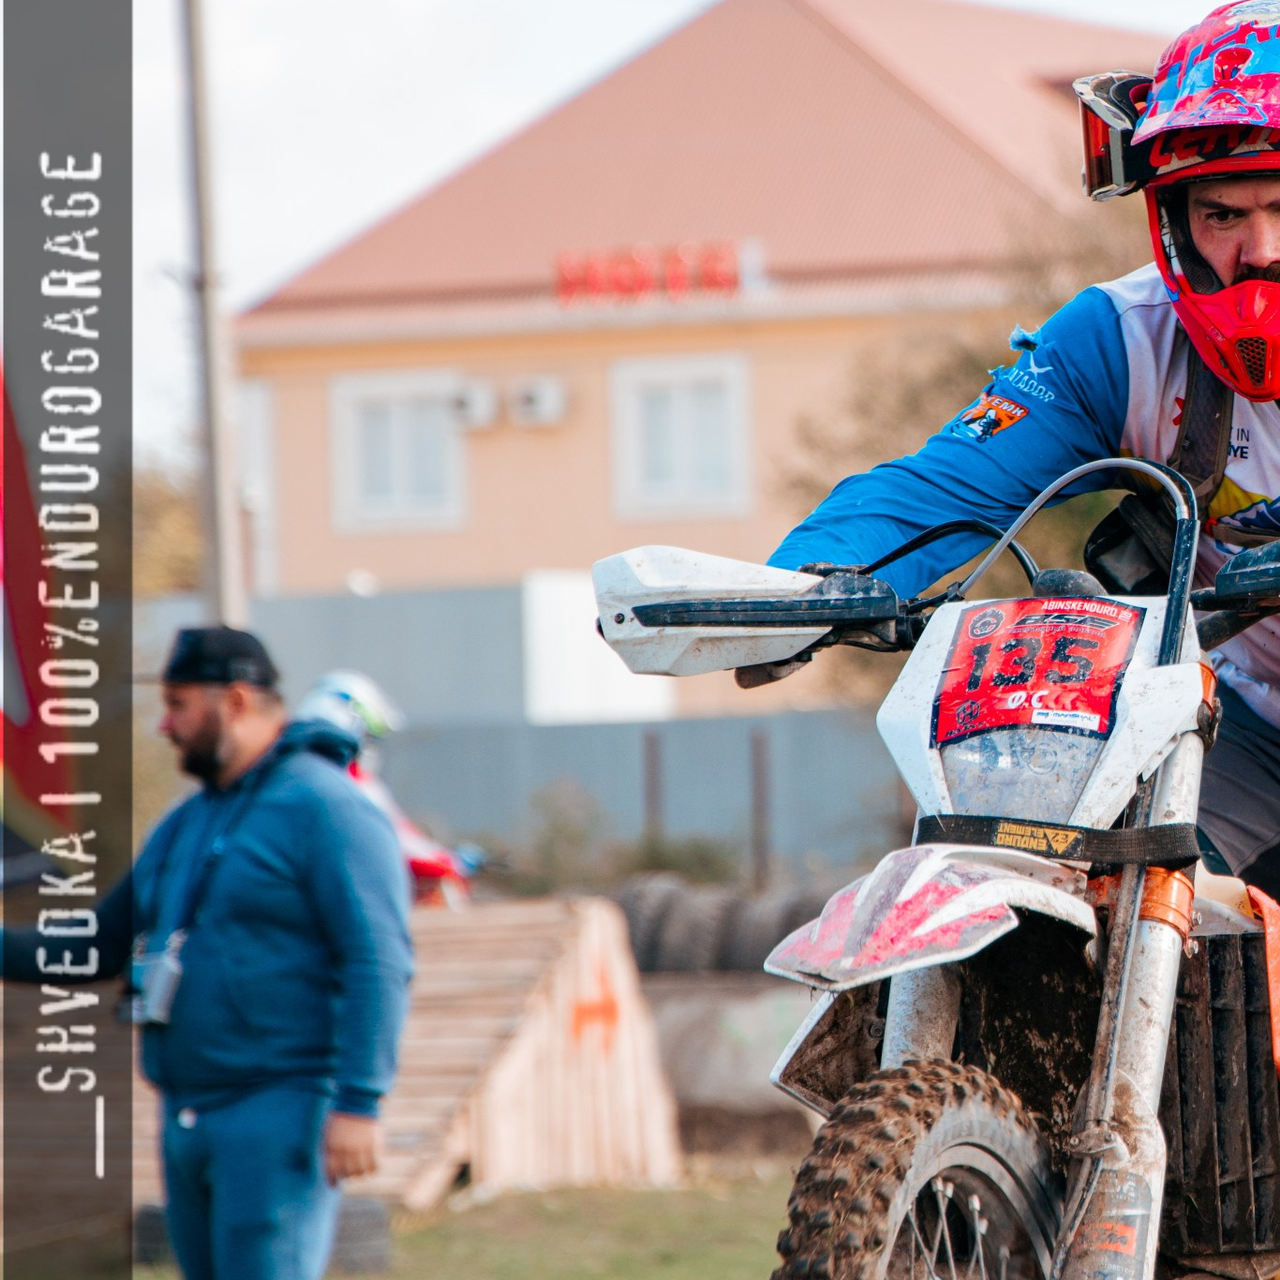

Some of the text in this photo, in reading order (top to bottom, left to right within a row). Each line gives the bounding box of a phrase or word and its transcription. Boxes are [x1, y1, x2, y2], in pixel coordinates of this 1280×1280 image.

[966, 635, 1099, 692] 135
[997, 822, 1044, 838] ELEMENT
[996, 833, 1048, 851] ENDURO
